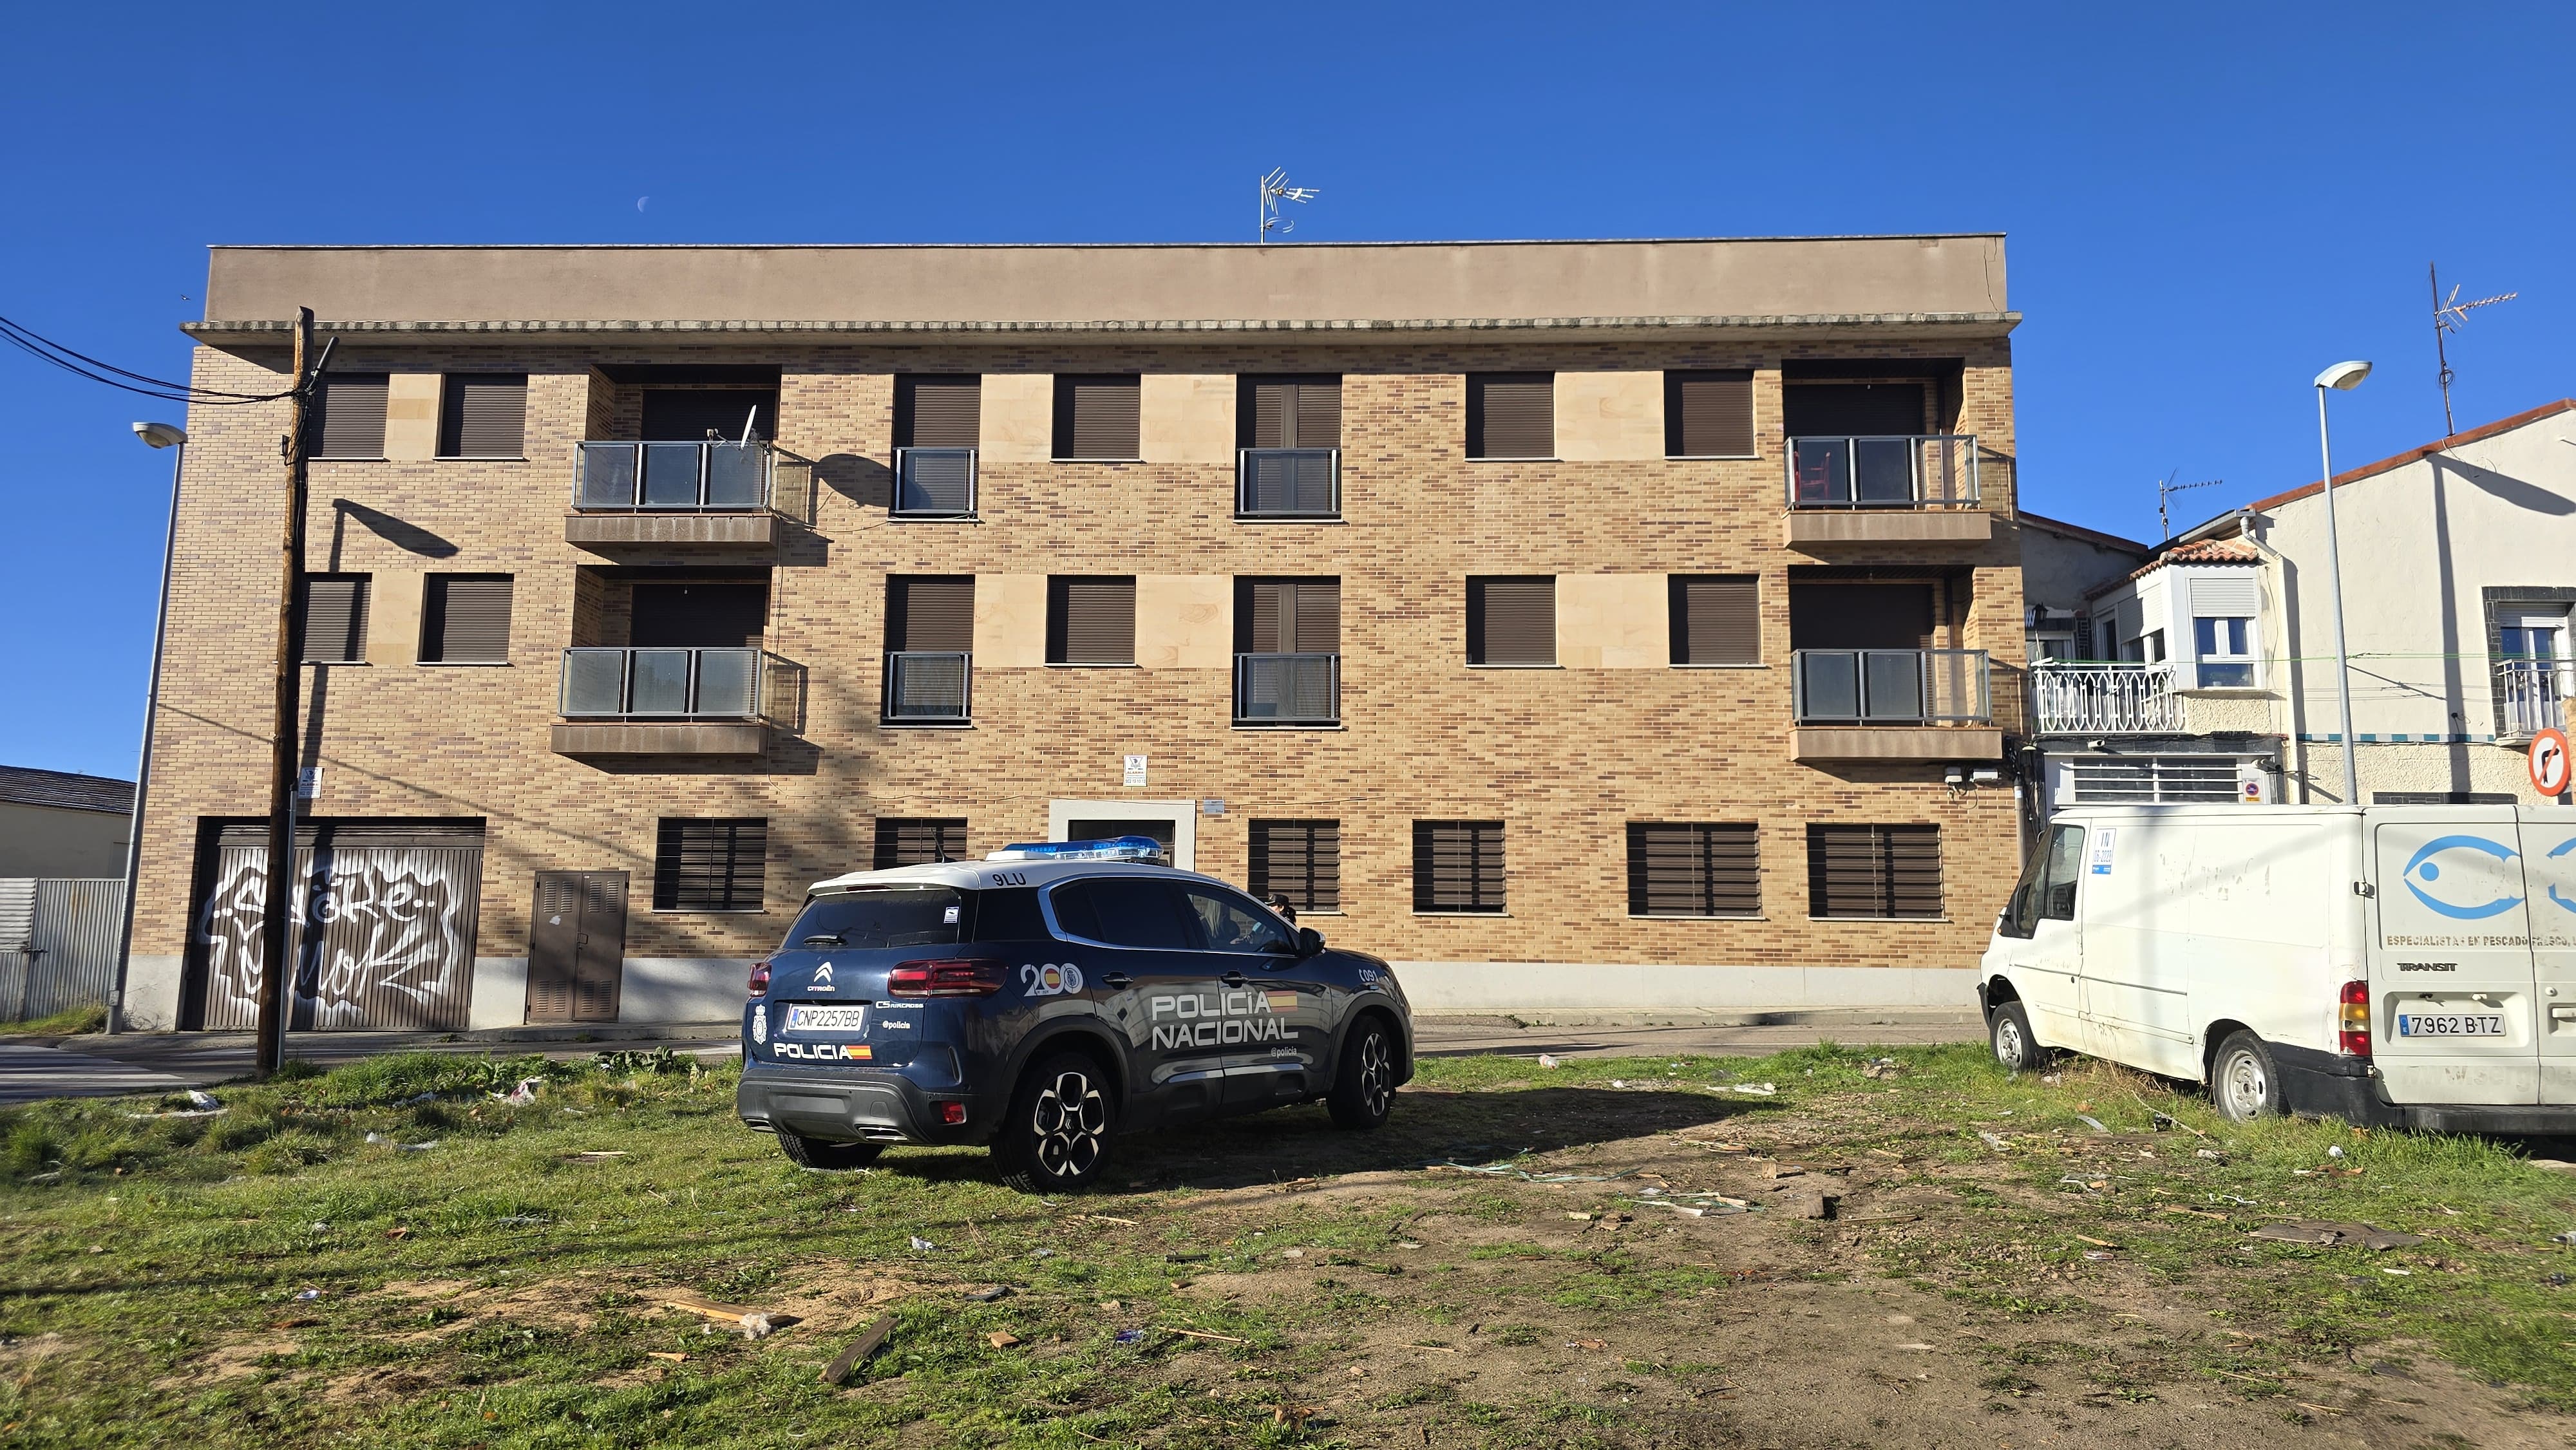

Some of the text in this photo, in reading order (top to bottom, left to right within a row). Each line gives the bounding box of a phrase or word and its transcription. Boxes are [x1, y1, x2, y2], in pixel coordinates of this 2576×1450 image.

[992, 872, 1026, 887] 9LU
[2397, 963, 2458, 972] TRANSIT
[875, 1001, 891, 1009] C5
[797, 1010, 860, 1026] CNP2257BB
[2411, 1017, 2460, 1033] 7962
[2465, 1017, 2501, 1033] BTZ
[1152, 1017, 1299, 1051] NACIONAL
